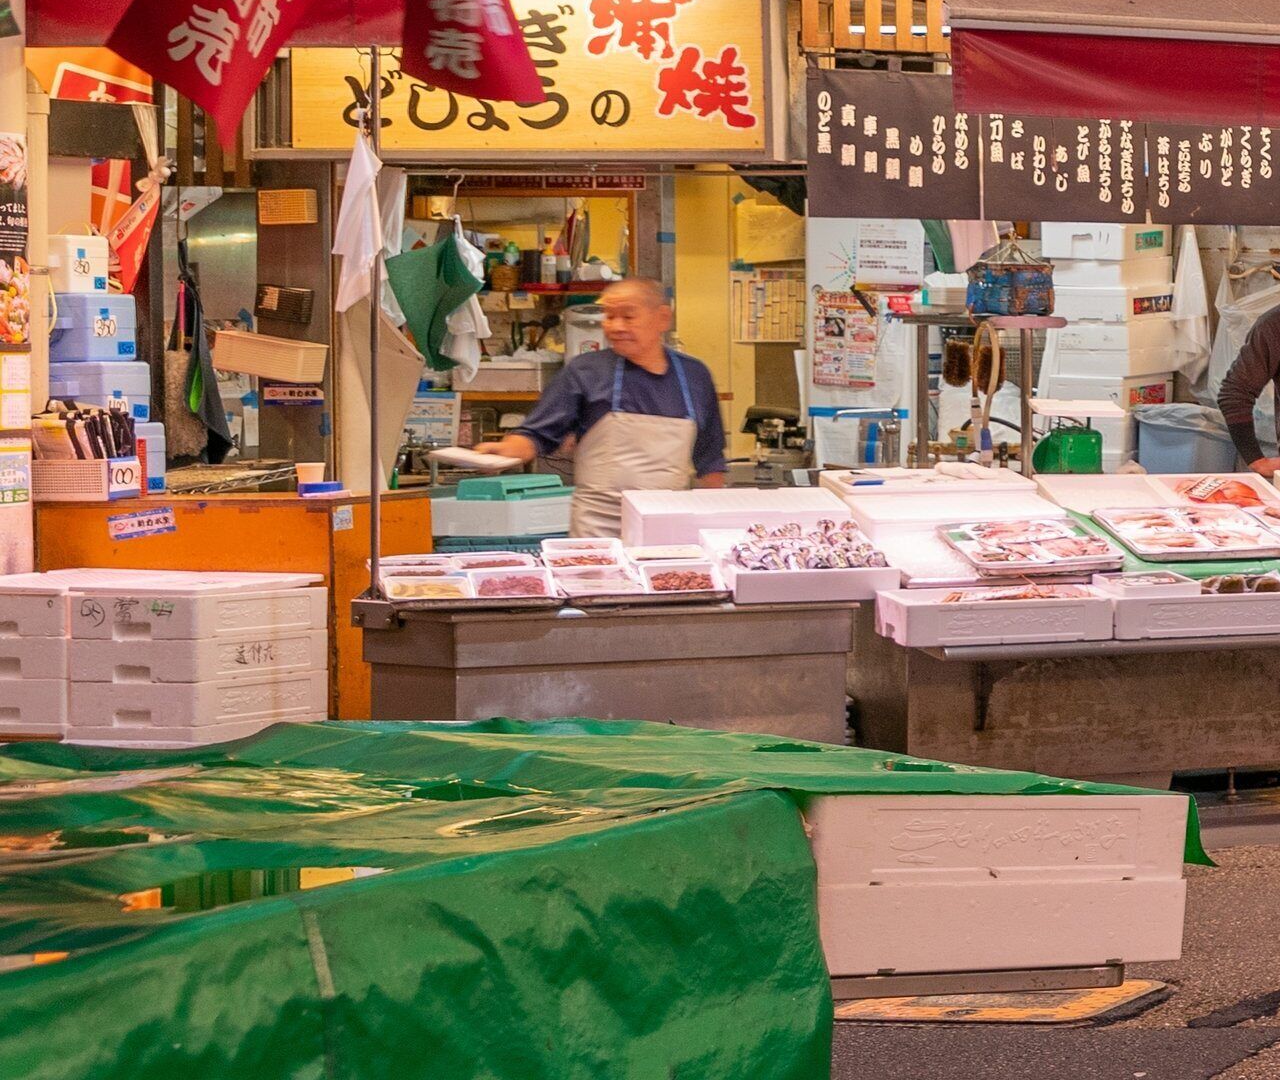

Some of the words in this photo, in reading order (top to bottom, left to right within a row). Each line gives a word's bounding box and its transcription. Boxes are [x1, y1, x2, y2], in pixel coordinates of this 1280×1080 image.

[932, 115, 946, 175] ひらめ
[989, 114, 1004, 163] 刀魚
[1011, 120, 1025, 170] さば
[1033, 135, 1046, 186] いわし
[1077, 125, 1091, 183] とび魚
[1055, 145, 1069, 191] あじ
